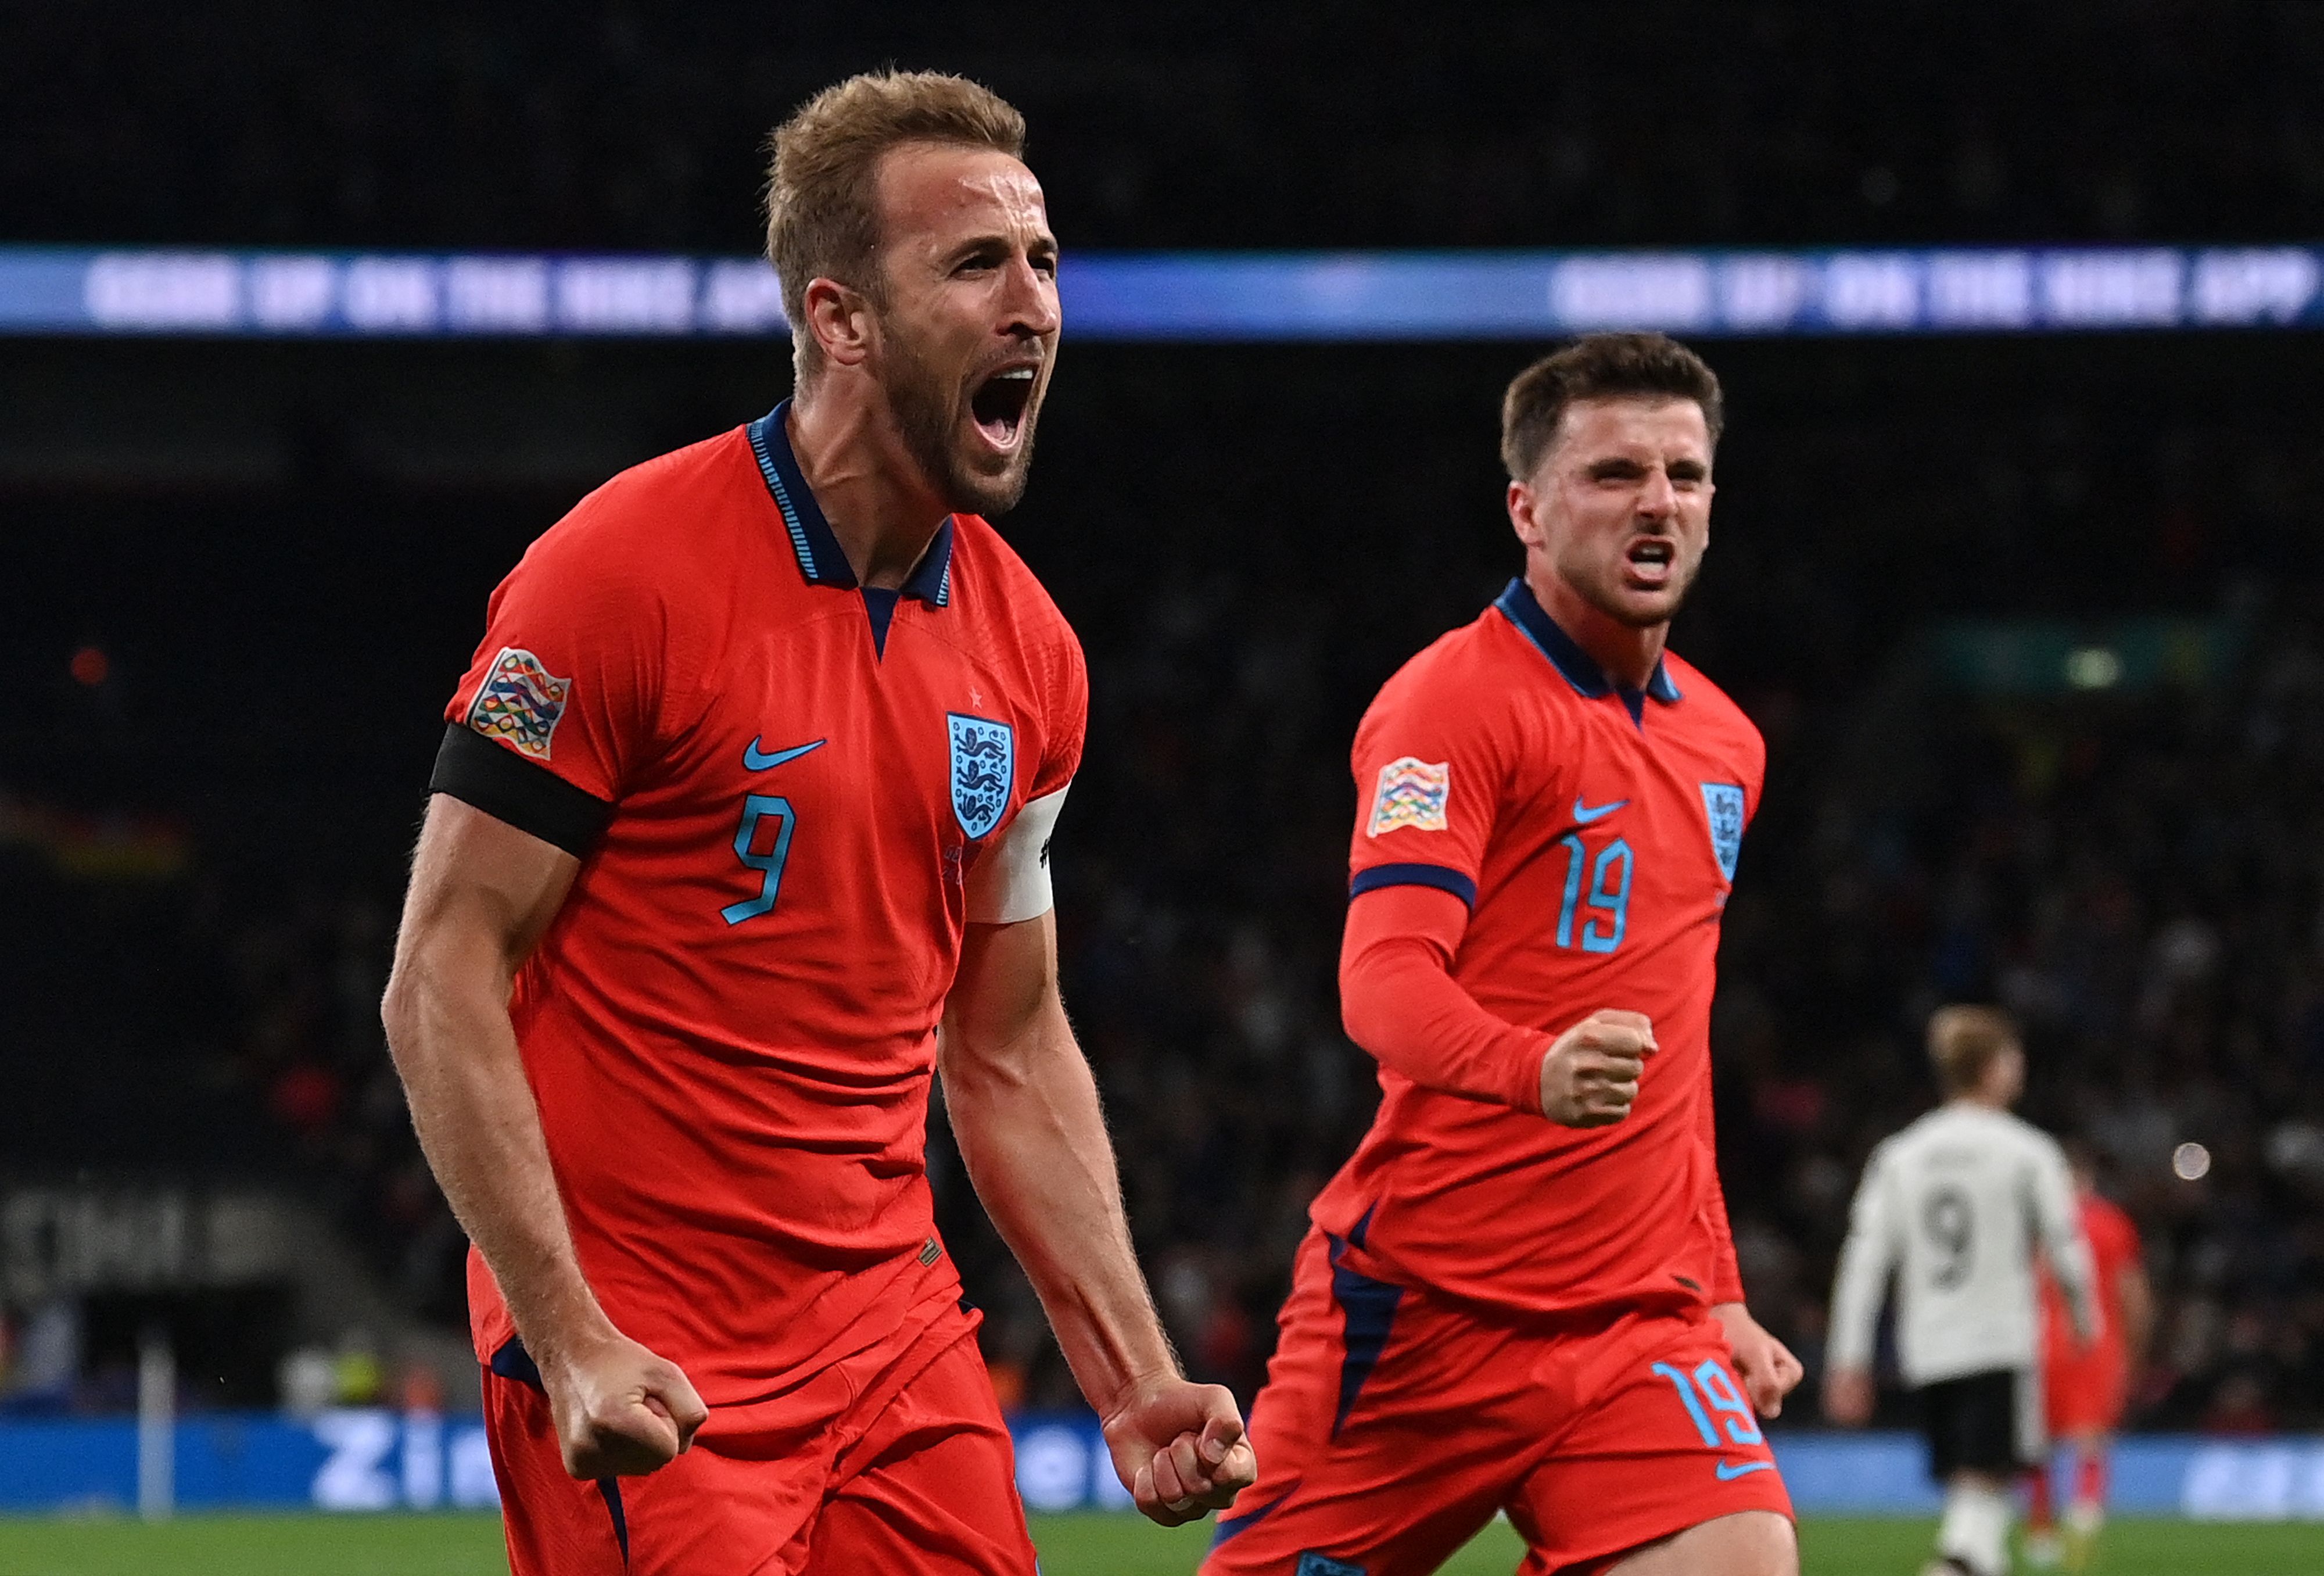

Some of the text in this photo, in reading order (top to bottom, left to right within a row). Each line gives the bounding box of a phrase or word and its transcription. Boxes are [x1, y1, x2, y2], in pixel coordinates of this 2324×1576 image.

[720, 794, 796, 925] 9
[1555, 833, 1634, 954] 19
[1920, 1183, 1977, 1294] 9
[1650, 1357, 1764, 1447] 19
